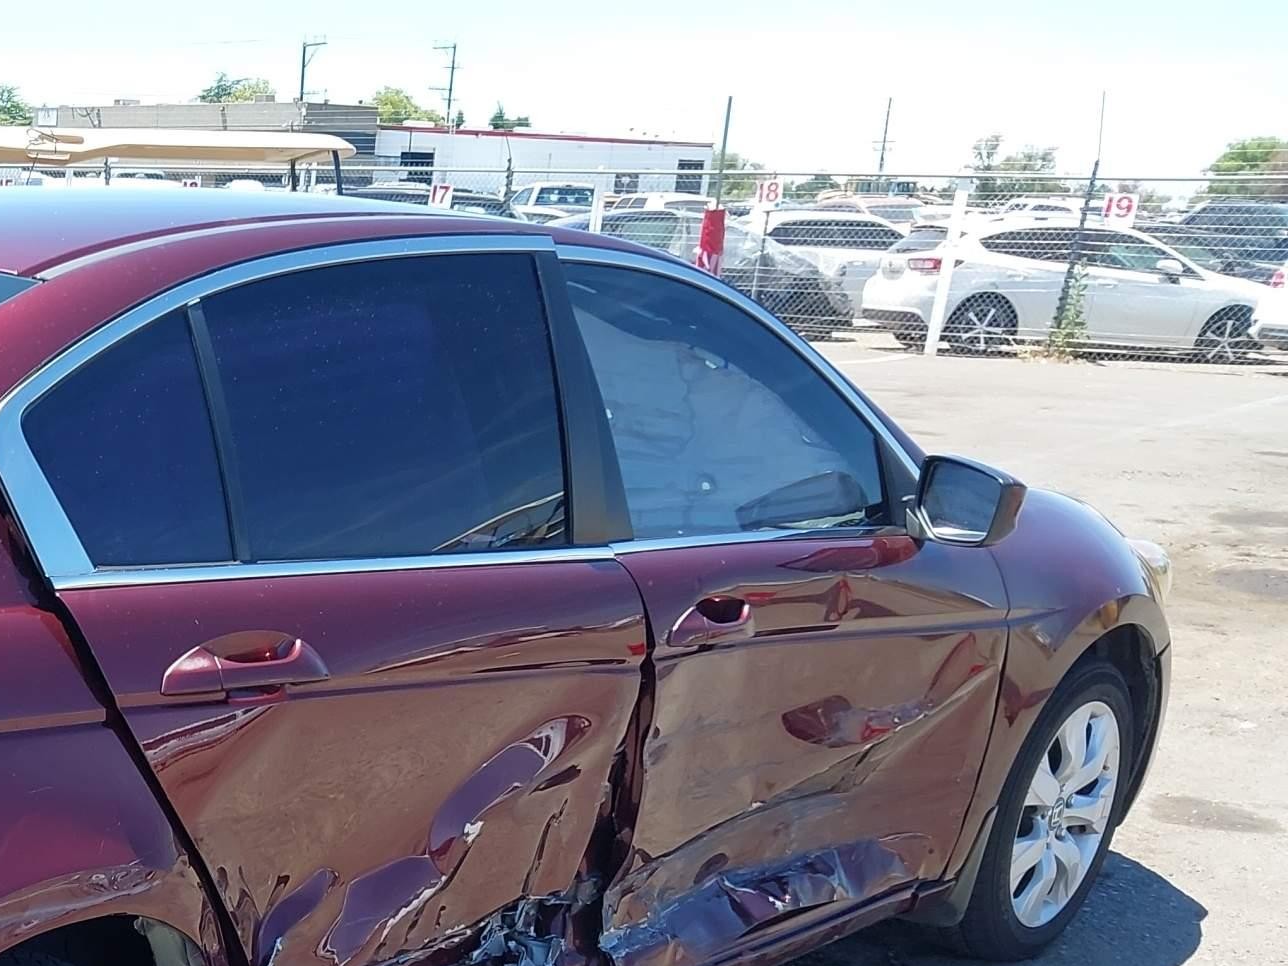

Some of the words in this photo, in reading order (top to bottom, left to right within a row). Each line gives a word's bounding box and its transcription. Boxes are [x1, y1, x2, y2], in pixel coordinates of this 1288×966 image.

[431, 184, 451, 204] 17
[758, 182, 780, 203] 18
[1104, 196, 1133, 218] 19
